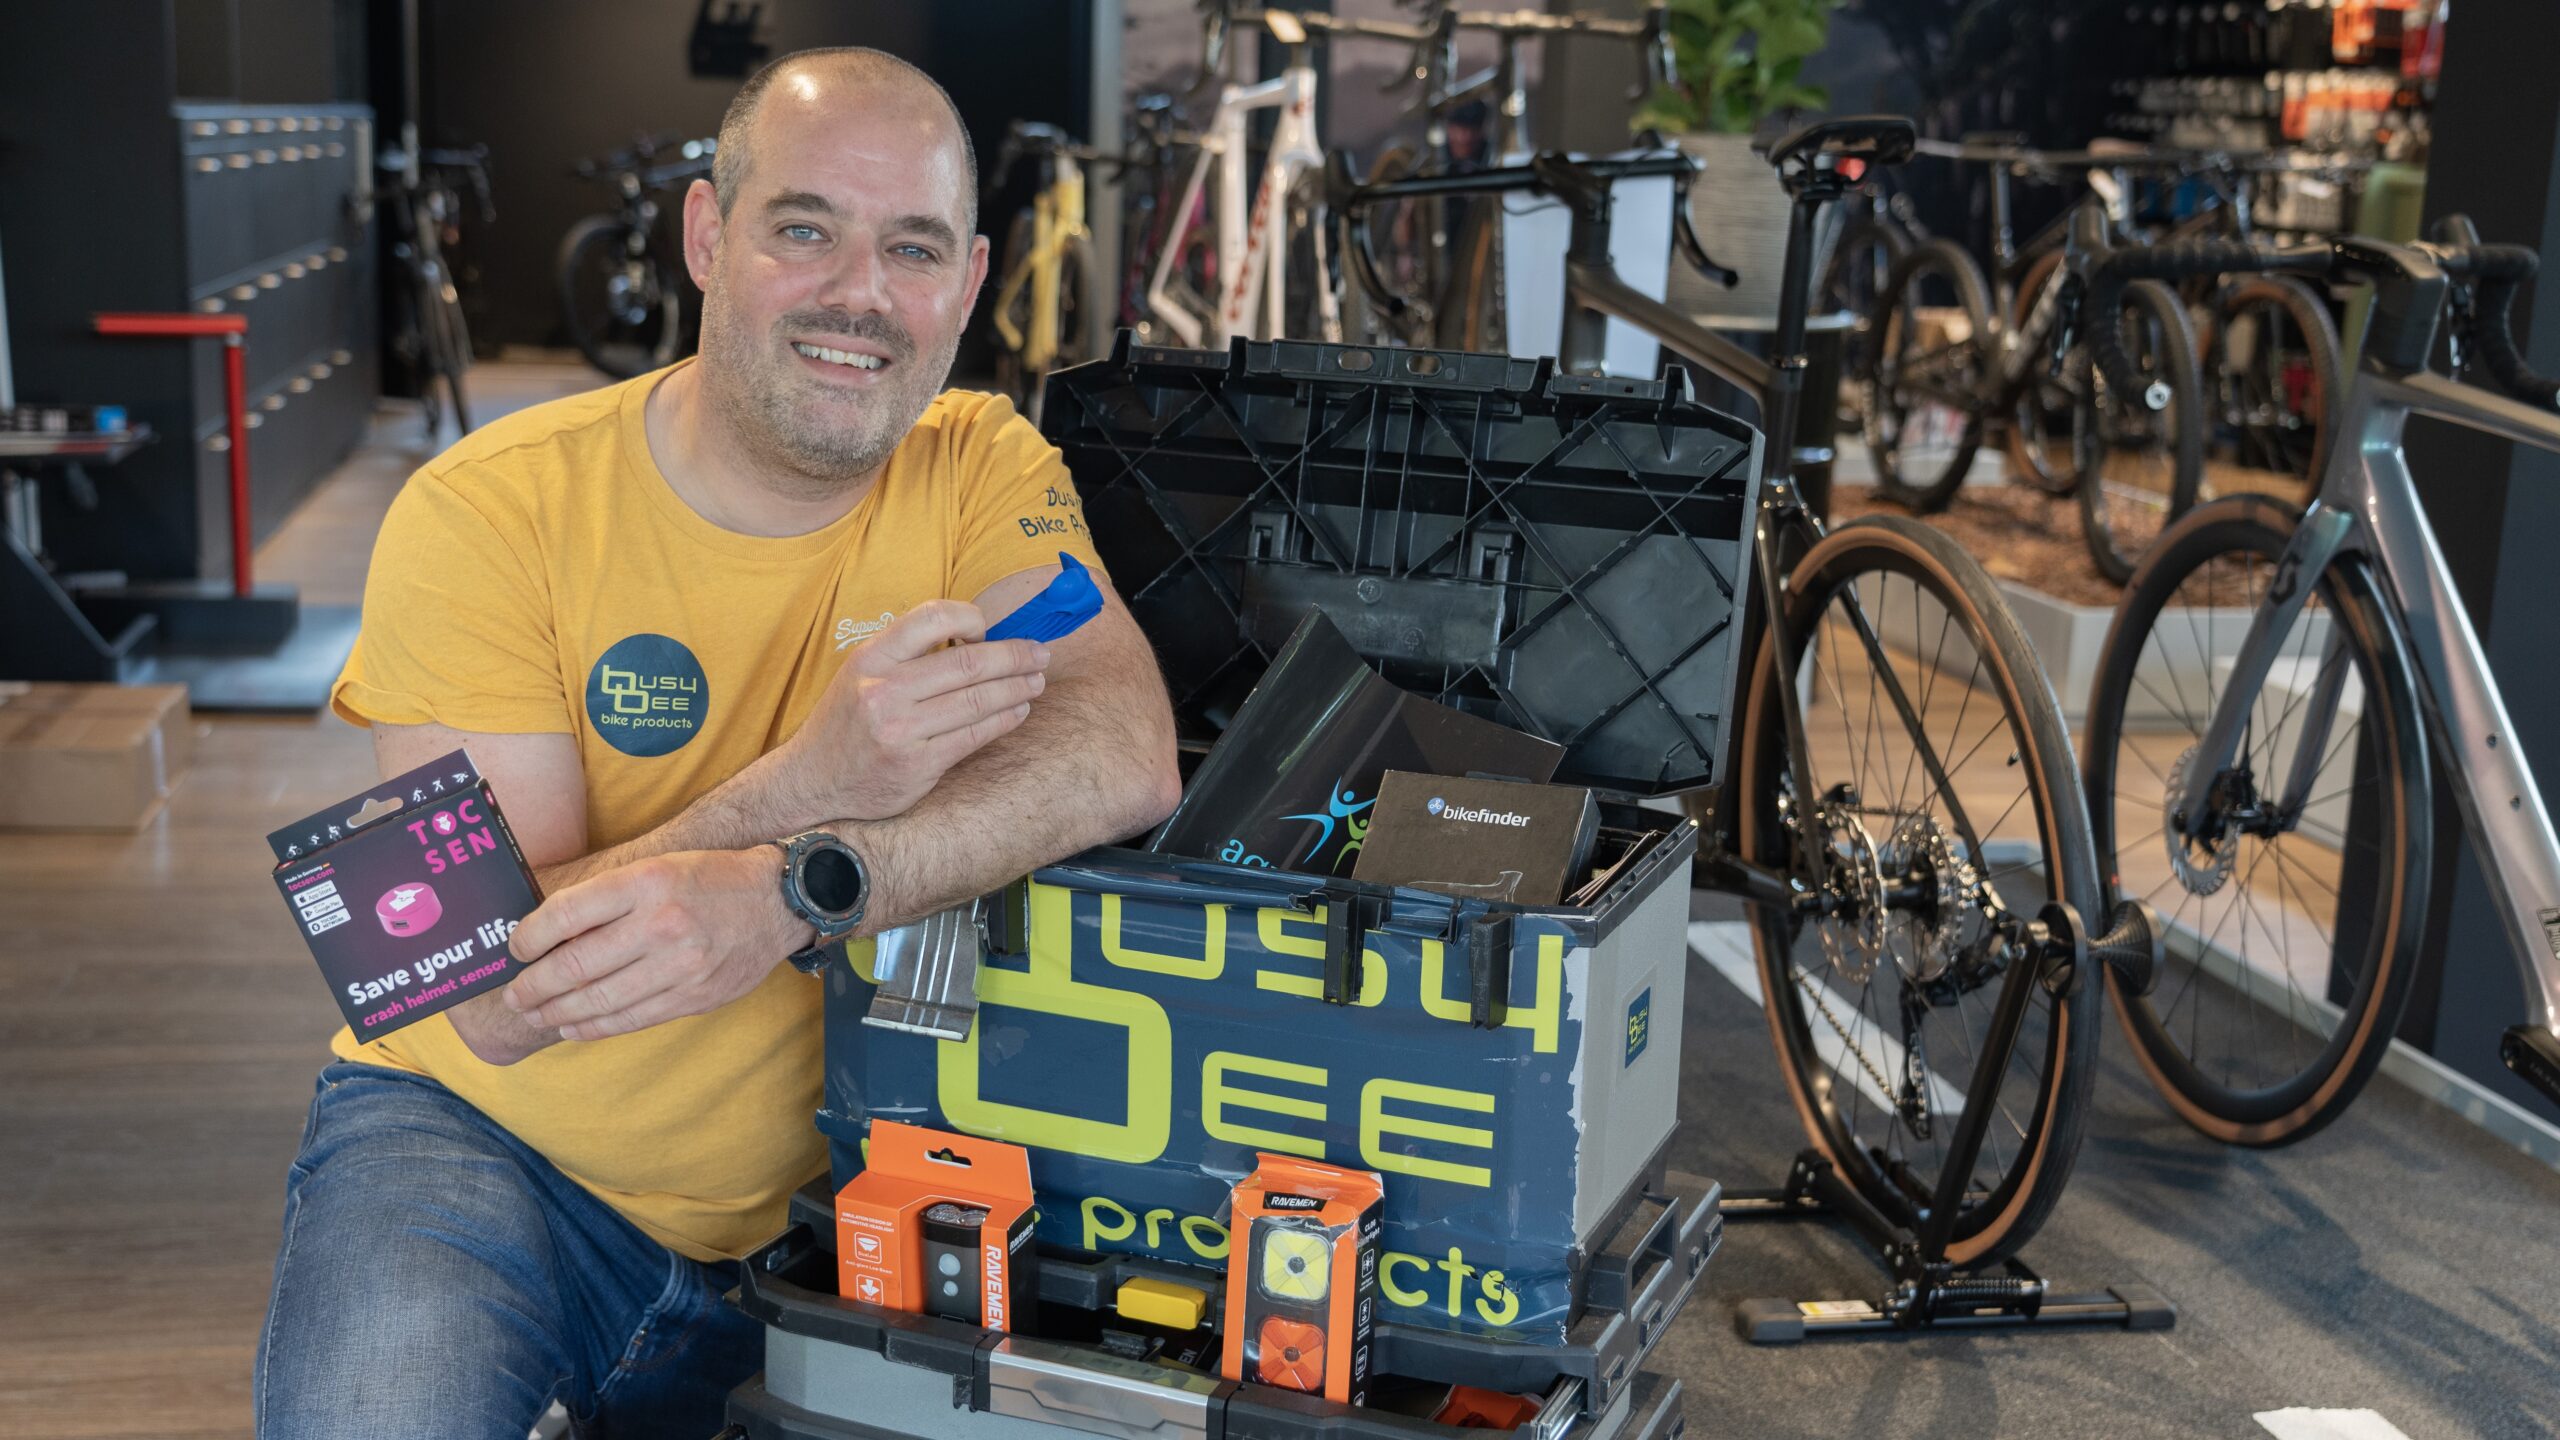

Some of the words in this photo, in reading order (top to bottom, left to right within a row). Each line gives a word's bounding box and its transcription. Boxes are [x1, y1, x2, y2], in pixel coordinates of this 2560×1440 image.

[1018, 515, 1068, 538] Bike
[601, 713, 629, 726] bike
[633, 716, 693, 730] products
[1442, 804, 1531, 828] bikefinder
[425, 827, 497, 874] SEN
[288, 867, 335, 891] tocsen.com
[348, 967, 411, 1006] Save
[415, 937, 474, 983] your
[363, 1001, 405, 1027] crash
[405, 977, 458, 1011] helmet
[459, 955, 508, 986] sensor
[1271, 1195, 1318, 1207] RAVEMEN
[1081, 1196, 1521, 1326] procts
[986, 1244, 1003, 1332] RAVEMEN
